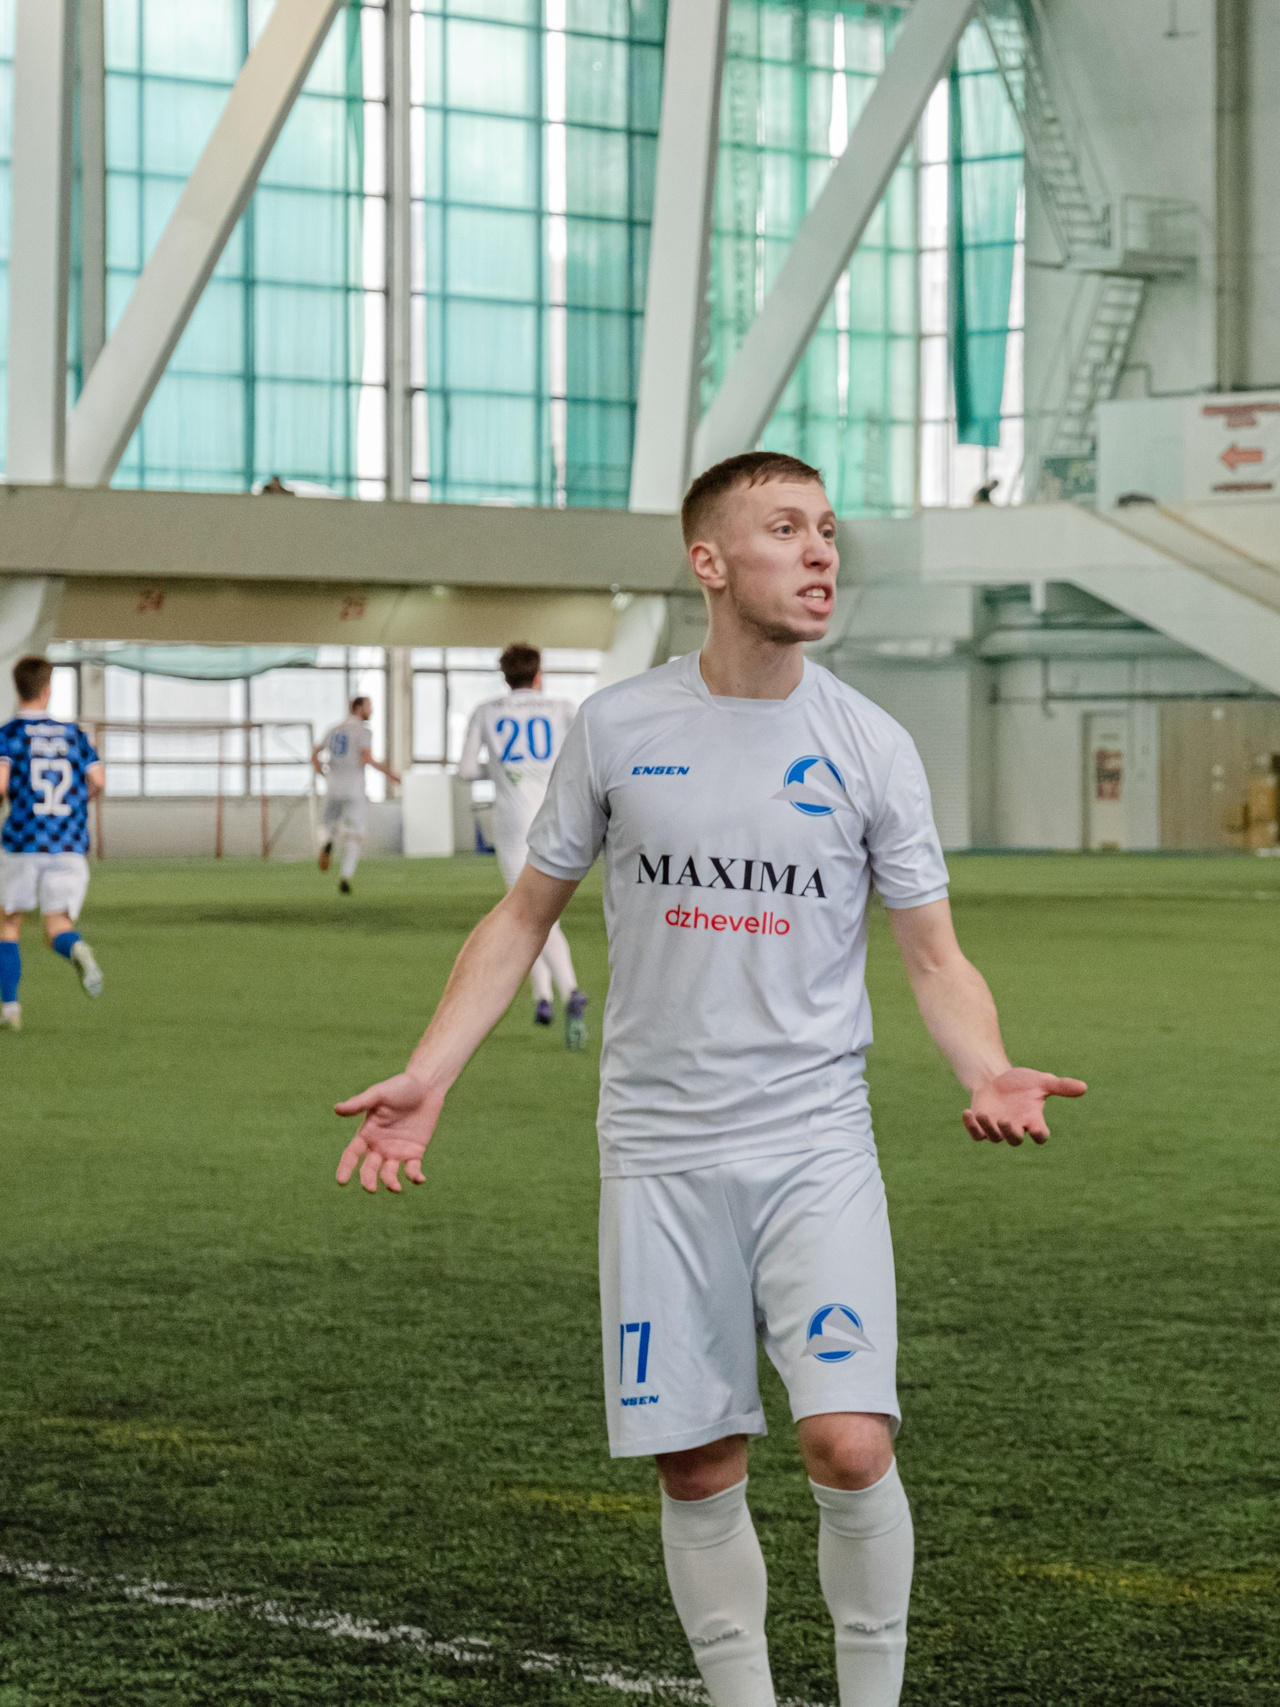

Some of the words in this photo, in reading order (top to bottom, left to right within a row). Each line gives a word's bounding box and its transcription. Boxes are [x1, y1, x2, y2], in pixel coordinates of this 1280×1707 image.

[496, 716, 552, 762] 20
[30, 758, 73, 816] 52
[631, 765, 691, 776] ENSEN
[635, 852, 828, 899] MAXIMA
[664, 904, 791, 936] dzhevello
